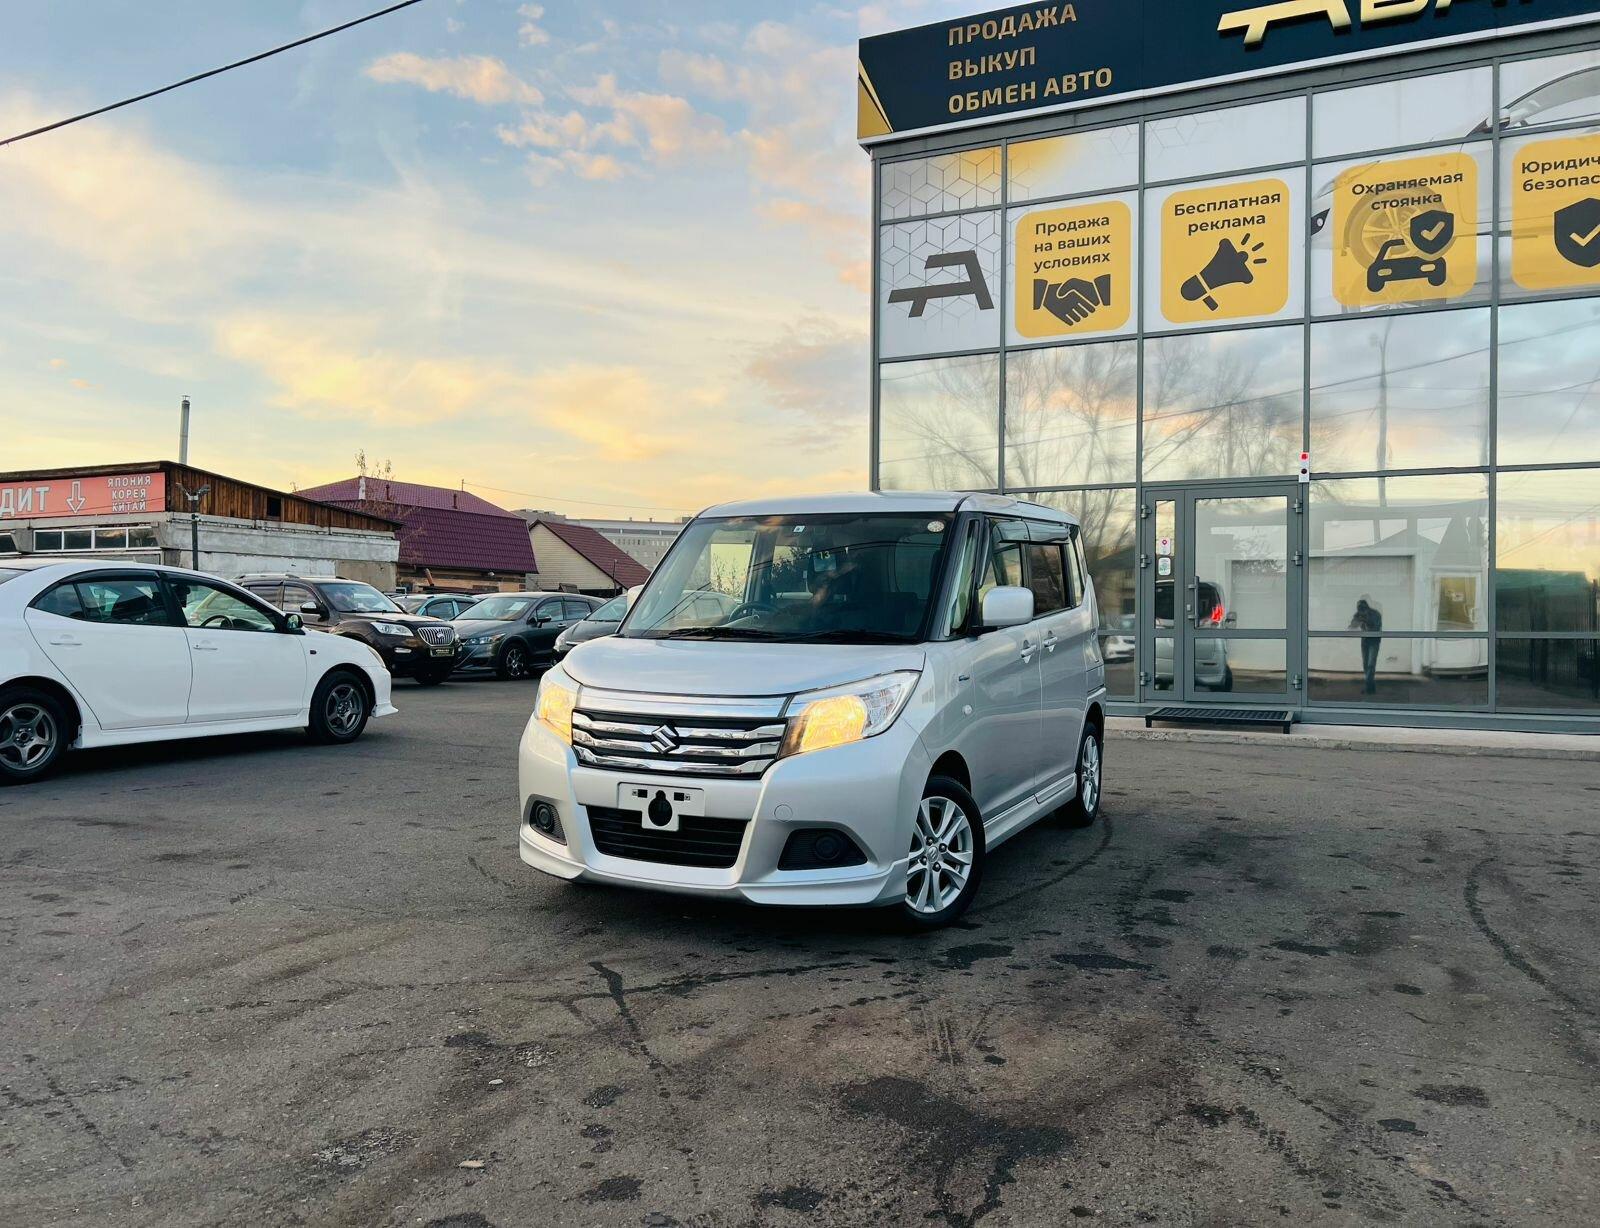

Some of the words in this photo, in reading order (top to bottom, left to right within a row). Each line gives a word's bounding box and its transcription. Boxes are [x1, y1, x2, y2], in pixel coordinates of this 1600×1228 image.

[949, 4, 1077, 46] ПРОДАЖА
[949, 46, 1036, 80] ВЫКУП
[949, 81, 1036, 114] ОБМЕН
[1043, 67, 1112, 97] АВТО
[1352, 173, 1463, 195] Охраняемая
[1523, 175, 1600, 192] безопас
[1174, 193, 1281, 216] Бесплатная
[1371, 194, 1442, 211] стоянка
[1035, 216, 1110, 236] Продажа
[1188, 214, 1266, 236] реклама
[1034, 242, 1053, 253] на
[1058, 234, 1111, 250] ваших
[1033, 252, 1111, 273] условиях
[107, 475, 151, 488] ЯПОНИЯ
[0, 486, 50, 517] ДИТ
[112, 488, 146, 500] КОРЕЯ
[112, 499, 146, 512] КИТАЙ
